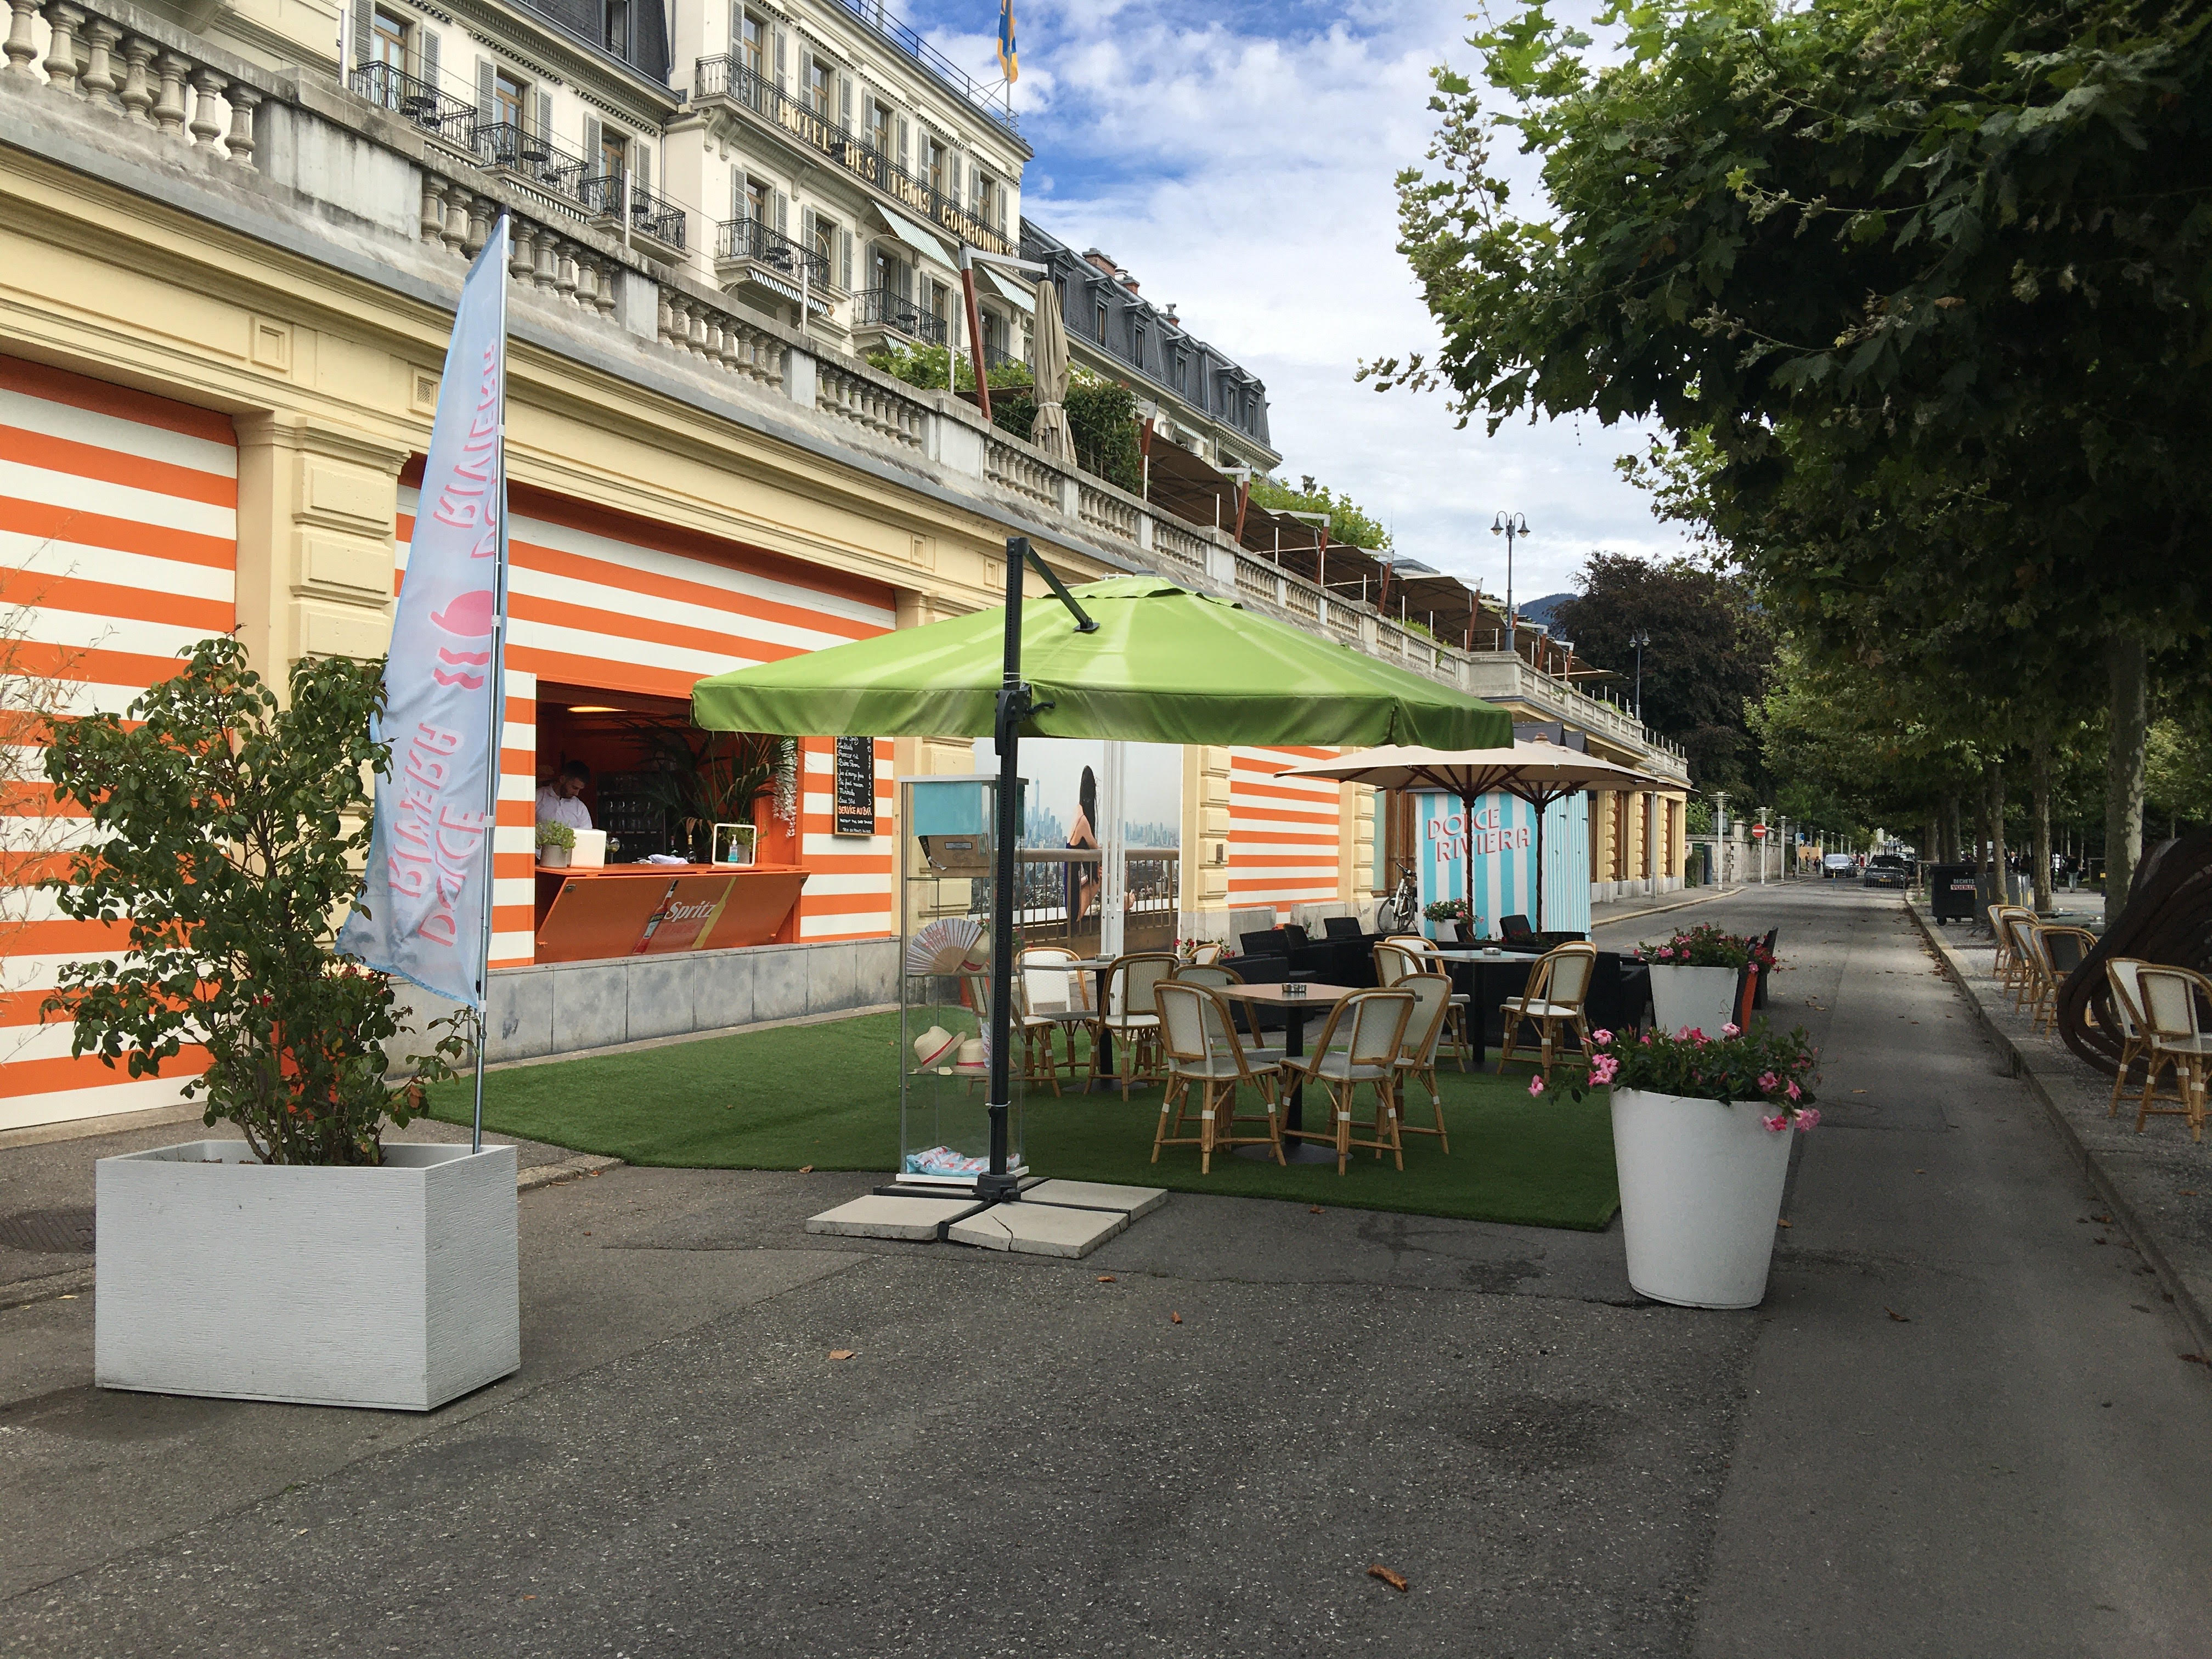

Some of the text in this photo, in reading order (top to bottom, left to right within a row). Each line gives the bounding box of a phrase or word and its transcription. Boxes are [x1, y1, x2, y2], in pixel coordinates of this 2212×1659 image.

[778, 98, 832, 155] HOTEL
[845, 141, 875, 181] DES
[890, 169, 930, 213] TROIS
[862, 806, 872, 816] BAR
[664, 900, 718, 922] Spritz
